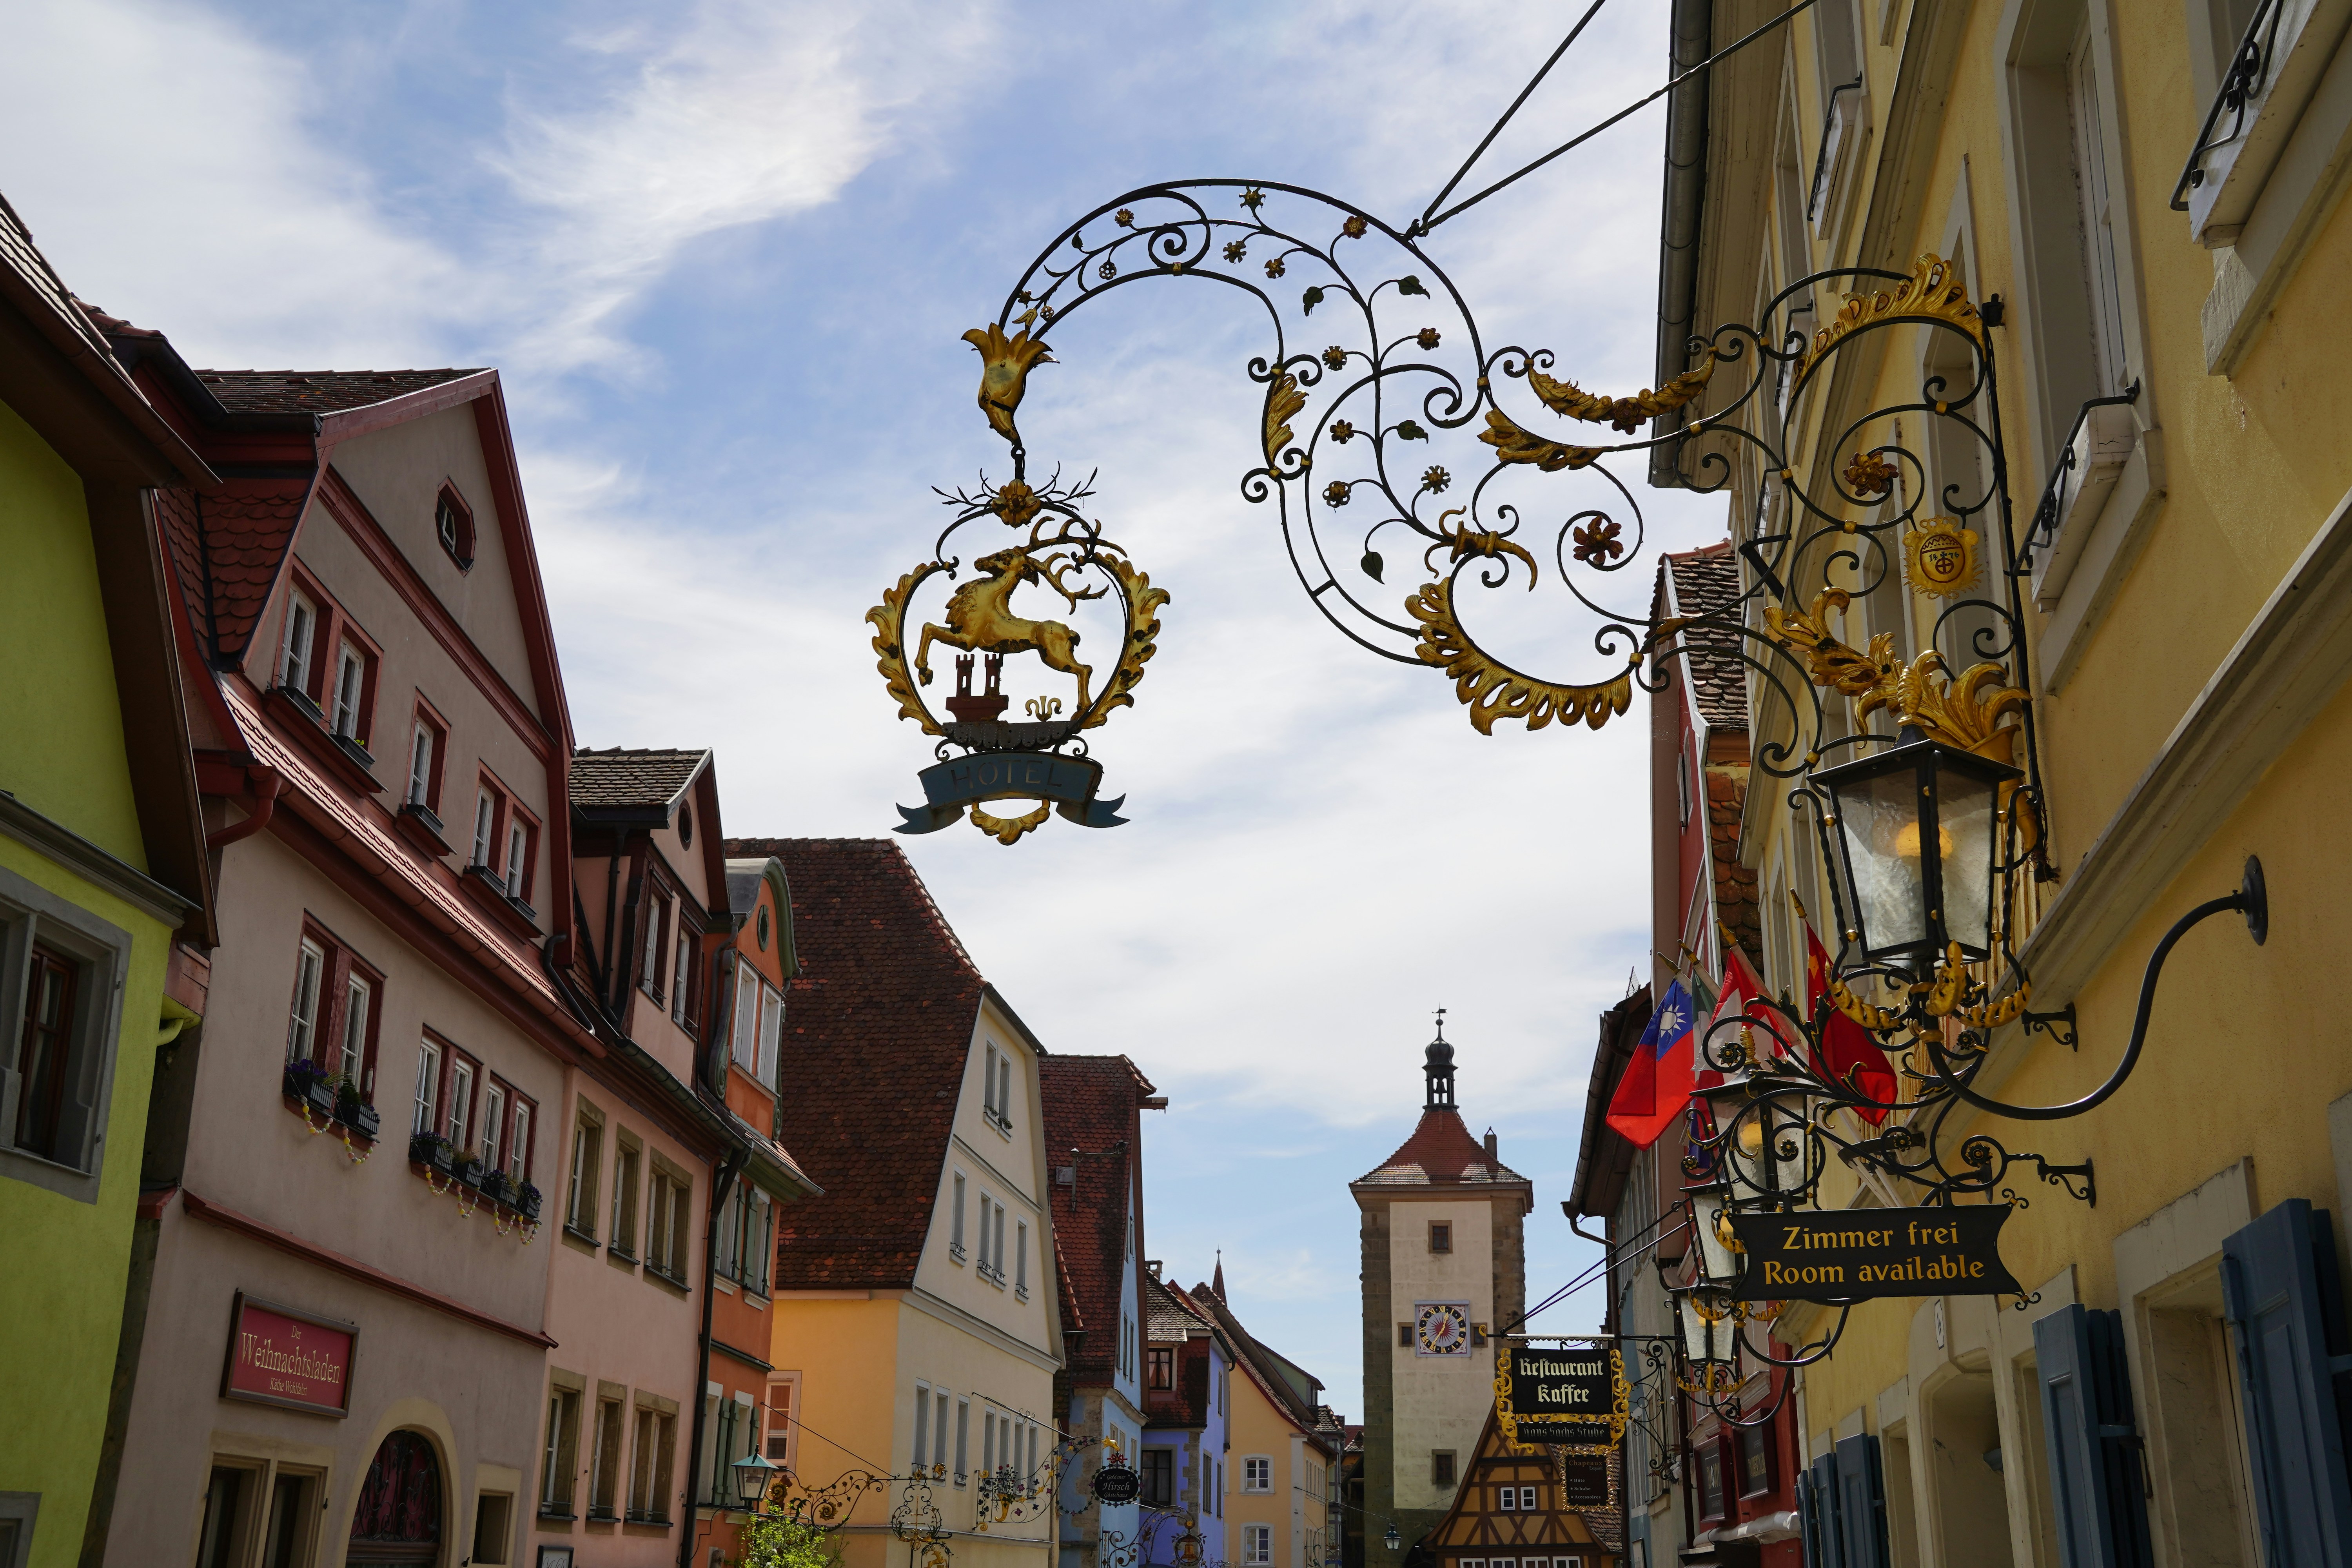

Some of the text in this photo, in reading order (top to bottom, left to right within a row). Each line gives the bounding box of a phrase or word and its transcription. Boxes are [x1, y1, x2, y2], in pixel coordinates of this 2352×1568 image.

[950, 760, 1062, 793] HOTEL
[1782, 1221, 1958, 1250] Zimmer frei
[1763, 1254, 1985, 1285] Room available
[291, 1325, 301, 1339] Der
[242, 1332, 340, 1383] Weihnachtsladen
[1519, 1357, 1604, 1378] Restaurant
[270, 1377, 307, 1396] Käthe Wohlfahrt
[1538, 1384, 1590, 1404] Kaffee
[1524, 1426, 1605, 1437] Hans Sachs Stube
[1102, 1481, 1130, 1490] Hirsch
